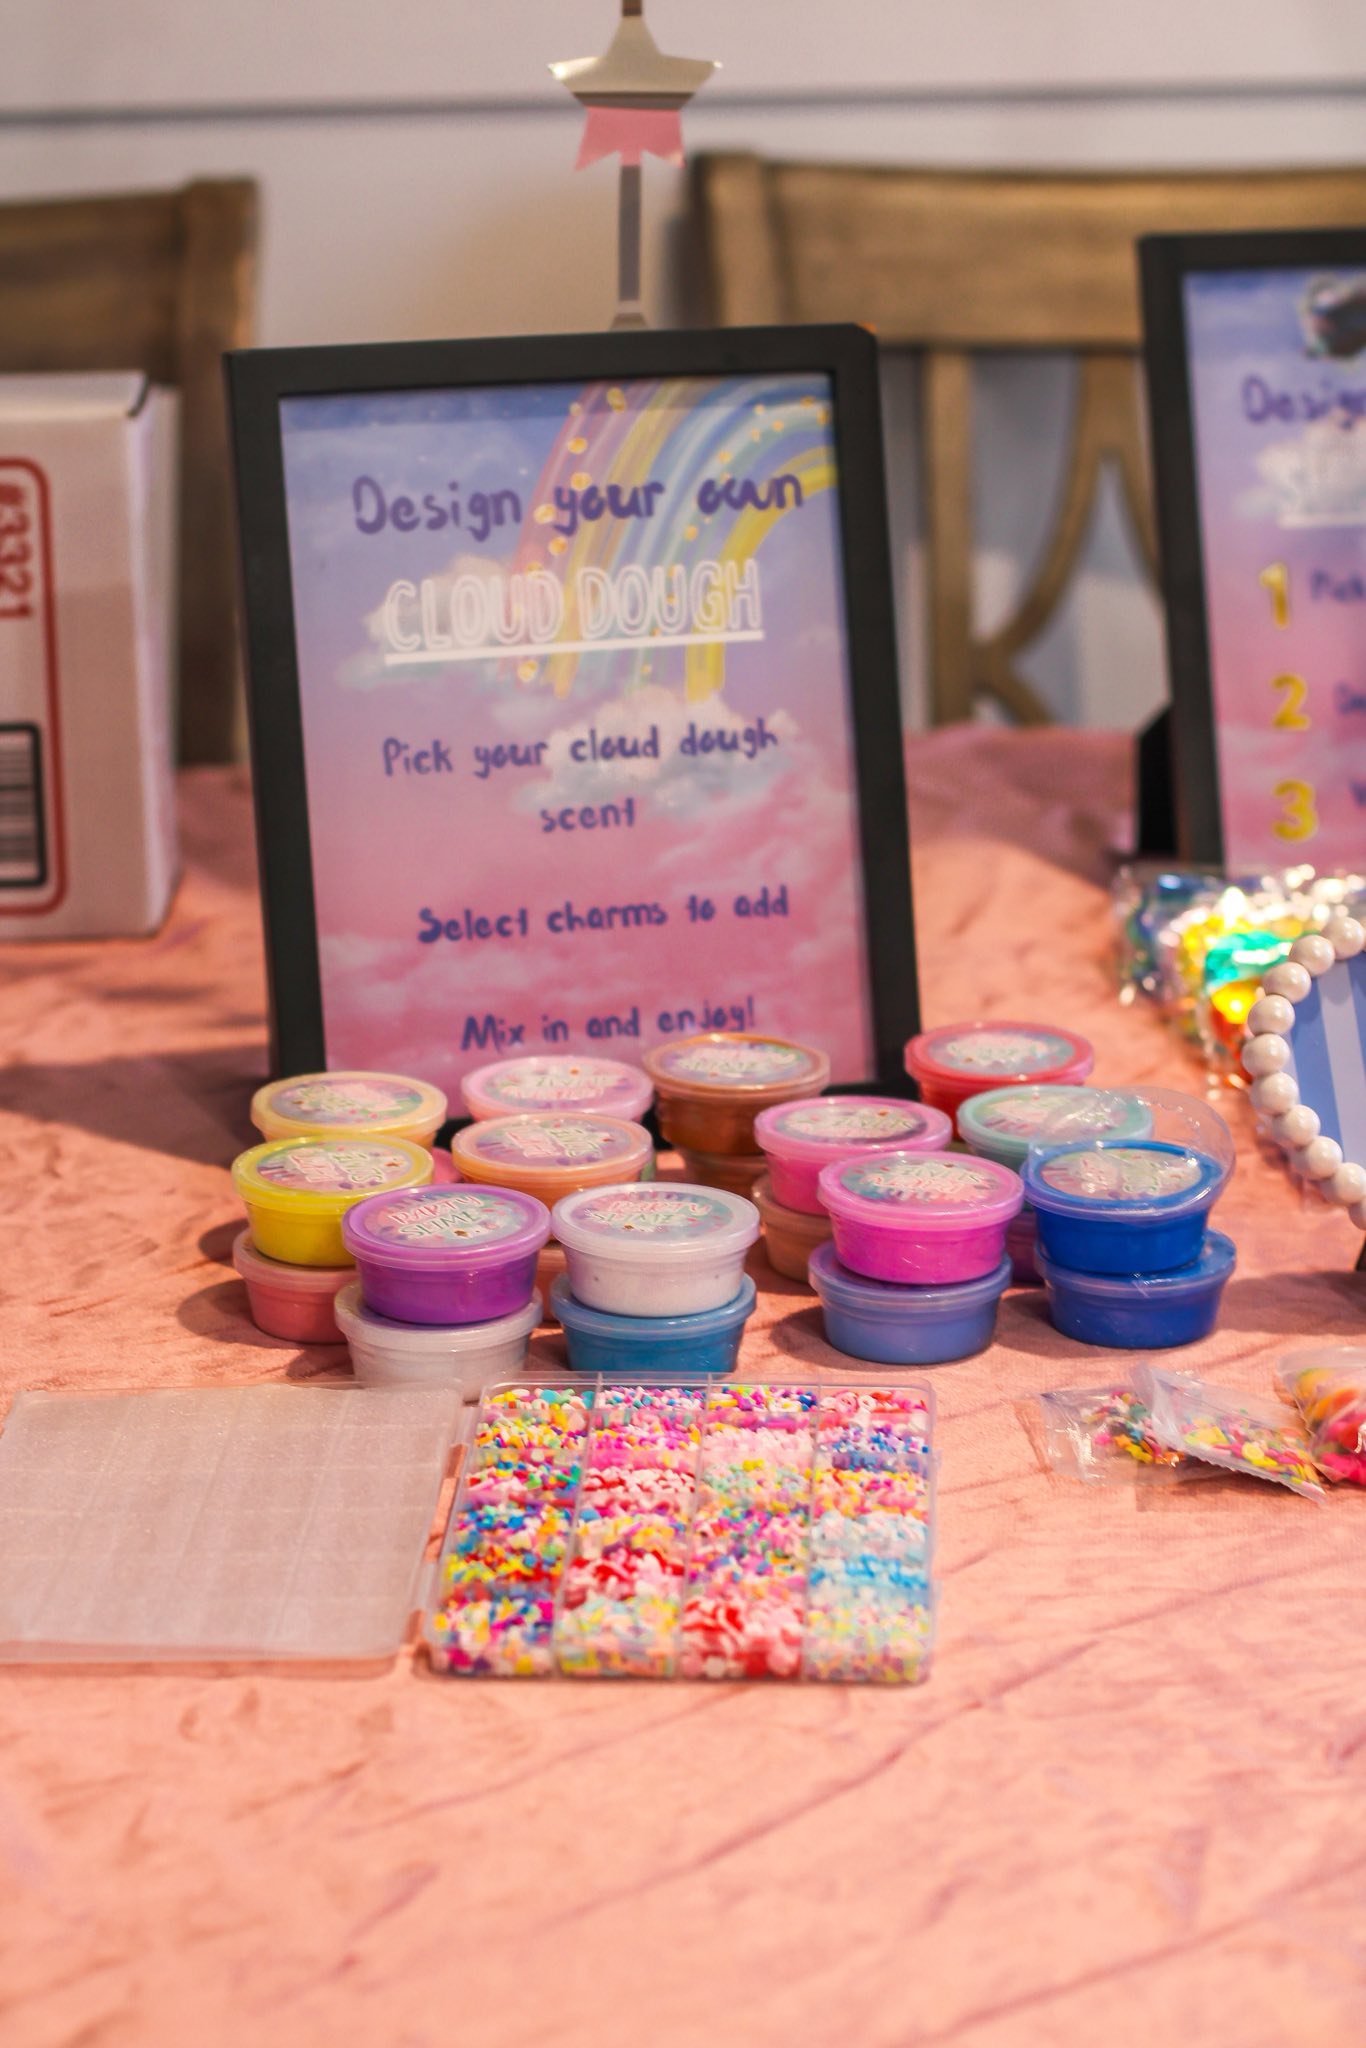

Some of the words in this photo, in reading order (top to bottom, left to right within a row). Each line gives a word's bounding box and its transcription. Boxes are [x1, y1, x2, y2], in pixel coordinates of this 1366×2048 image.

[352, 476, 522, 541] Design
[552, 481, 664, 535] your
[696, 474, 803, 514] own
[383, 572, 563, 650] CLOUD
[576, 558, 761, 635] DOUGH
[1260, 562, 1288, 629] 1
[1270, 674, 1310, 731] 2
[383, 737, 452, 776] Pick
[474, 741, 548, 779] your
[570, 725, 659, 763] cloud
[679, 718, 778, 759] dough
[540, 798, 635, 833] scent
[1272, 780, 1318, 843] 3
[417, 904, 528, 943] Select
[546, 896, 668, 933] charms
[687, 894, 715, 922] to
[734, 885, 788, 918] add
[461, 1015, 524, 1055] Mix
[541, 1015, 568, 1042] in
[586, 1007, 640, 1038] and
[658, 997, 754, 1034] enjoy!
